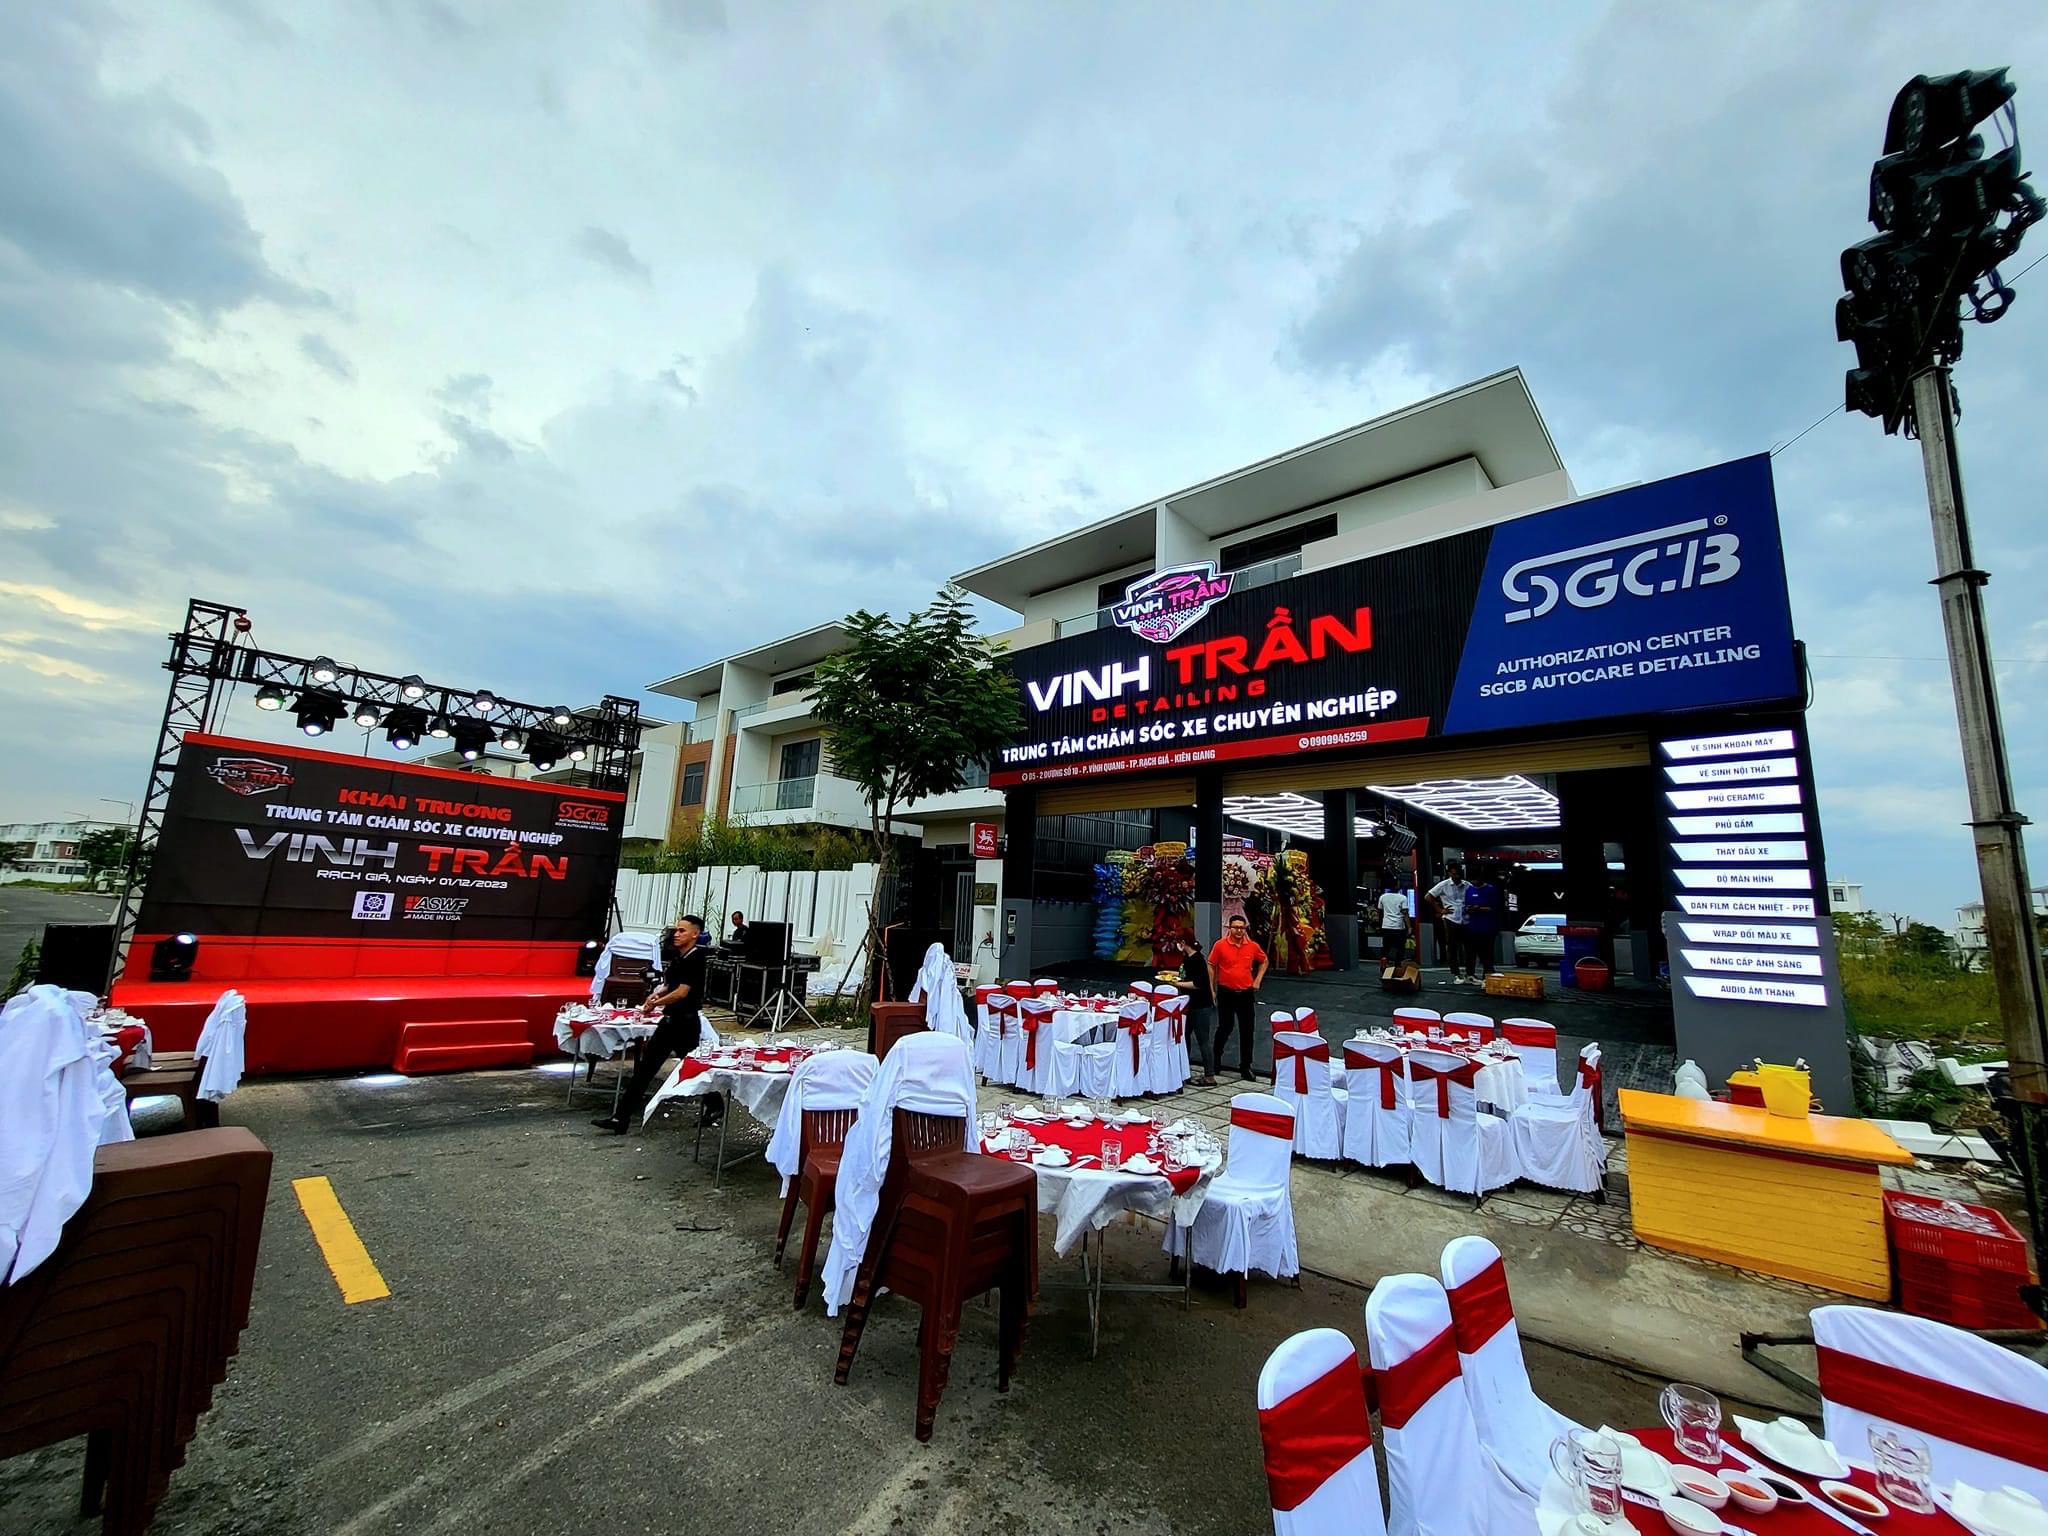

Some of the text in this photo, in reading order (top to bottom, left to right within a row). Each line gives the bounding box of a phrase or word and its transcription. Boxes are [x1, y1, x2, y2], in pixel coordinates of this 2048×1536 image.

[1502, 517, 1741, 624] SGCB
[1118, 598, 1163, 620] VINH
[1139, 601, 1200, 620] DETAILING
[1027, 606, 1372, 712] VINH TRẦN
[1496, 625, 1732, 675] AUTHORIZATION CENTER
[1479, 644, 1761, 697] SGCB AUTOCARE DETAILING
[1091, 679, 1266, 723] DETAILING
[1002, 687, 1398, 763] TRUNG TÂM CHĂM SÓC XE CHUYÊN NGHIỆP
[1310, 730, 1367, 747] 0909945259
[1702, 743, 1722, 751] SINH
[1104, 760, 1125, 772] QUANG
[1157, 753, 1170, 765] GIÁ
[1174, 752, 1191, 764] KIÊN
[1192, 749, 1216, 760] GIANG
[1711, 768, 1732, 777] SINH
[338, 788, 408, 810] KHAI
[1726, 793, 1766, 802] CERAMIC
[265, 804, 564, 847] TRUNG TÂM CHĂM SÓC XE CHUYÊN NGHIỆP
[234, 828, 568, 880] VINH TRẦN
[1716, 847, 1736, 856] THAY
[1758, 847, 1769, 856] XE
[316, 869, 361, 880] RẠCH
[396, 873, 436, 885] NGÀY
[439, 877, 508, 889] 01/12/2023
[413, 896, 469, 912] ASWF
[1710, 902, 1729, 911] FILM
[1792, 904, 1810, 912] PPF
[1712, 929, 1738, 938] WRAP
[1780, 932, 1791, 940] XE
[1720, 985, 1746, 994] AUDIO
[1765, 988, 1795, 997] THANH
